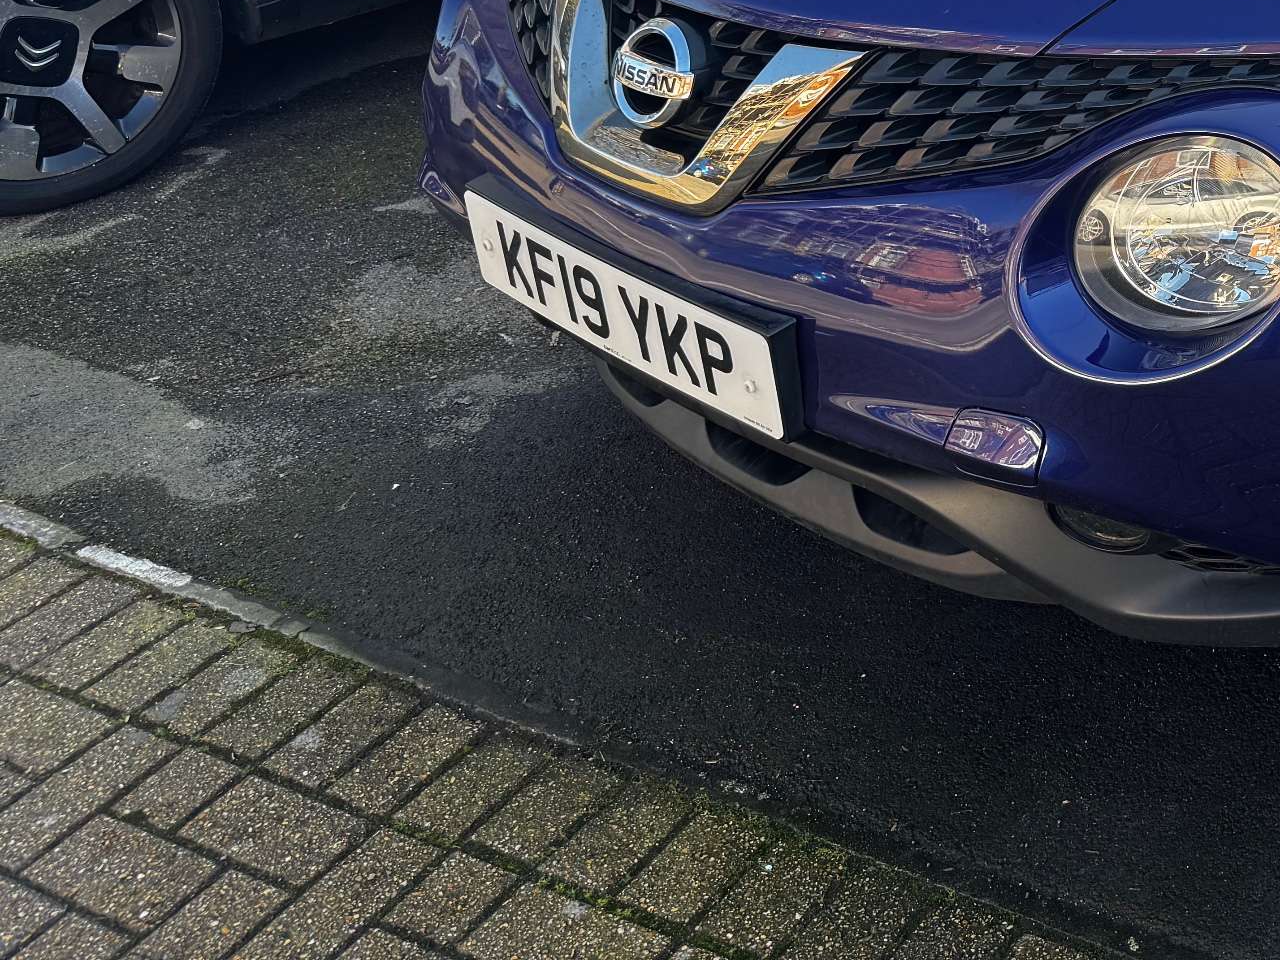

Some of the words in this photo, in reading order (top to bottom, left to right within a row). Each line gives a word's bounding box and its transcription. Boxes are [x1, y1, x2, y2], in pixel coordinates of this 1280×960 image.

[613, 57, 677, 94] NISSAN
[496, 219, 611, 339] KF19
[618, 284, 734, 396] YKP
